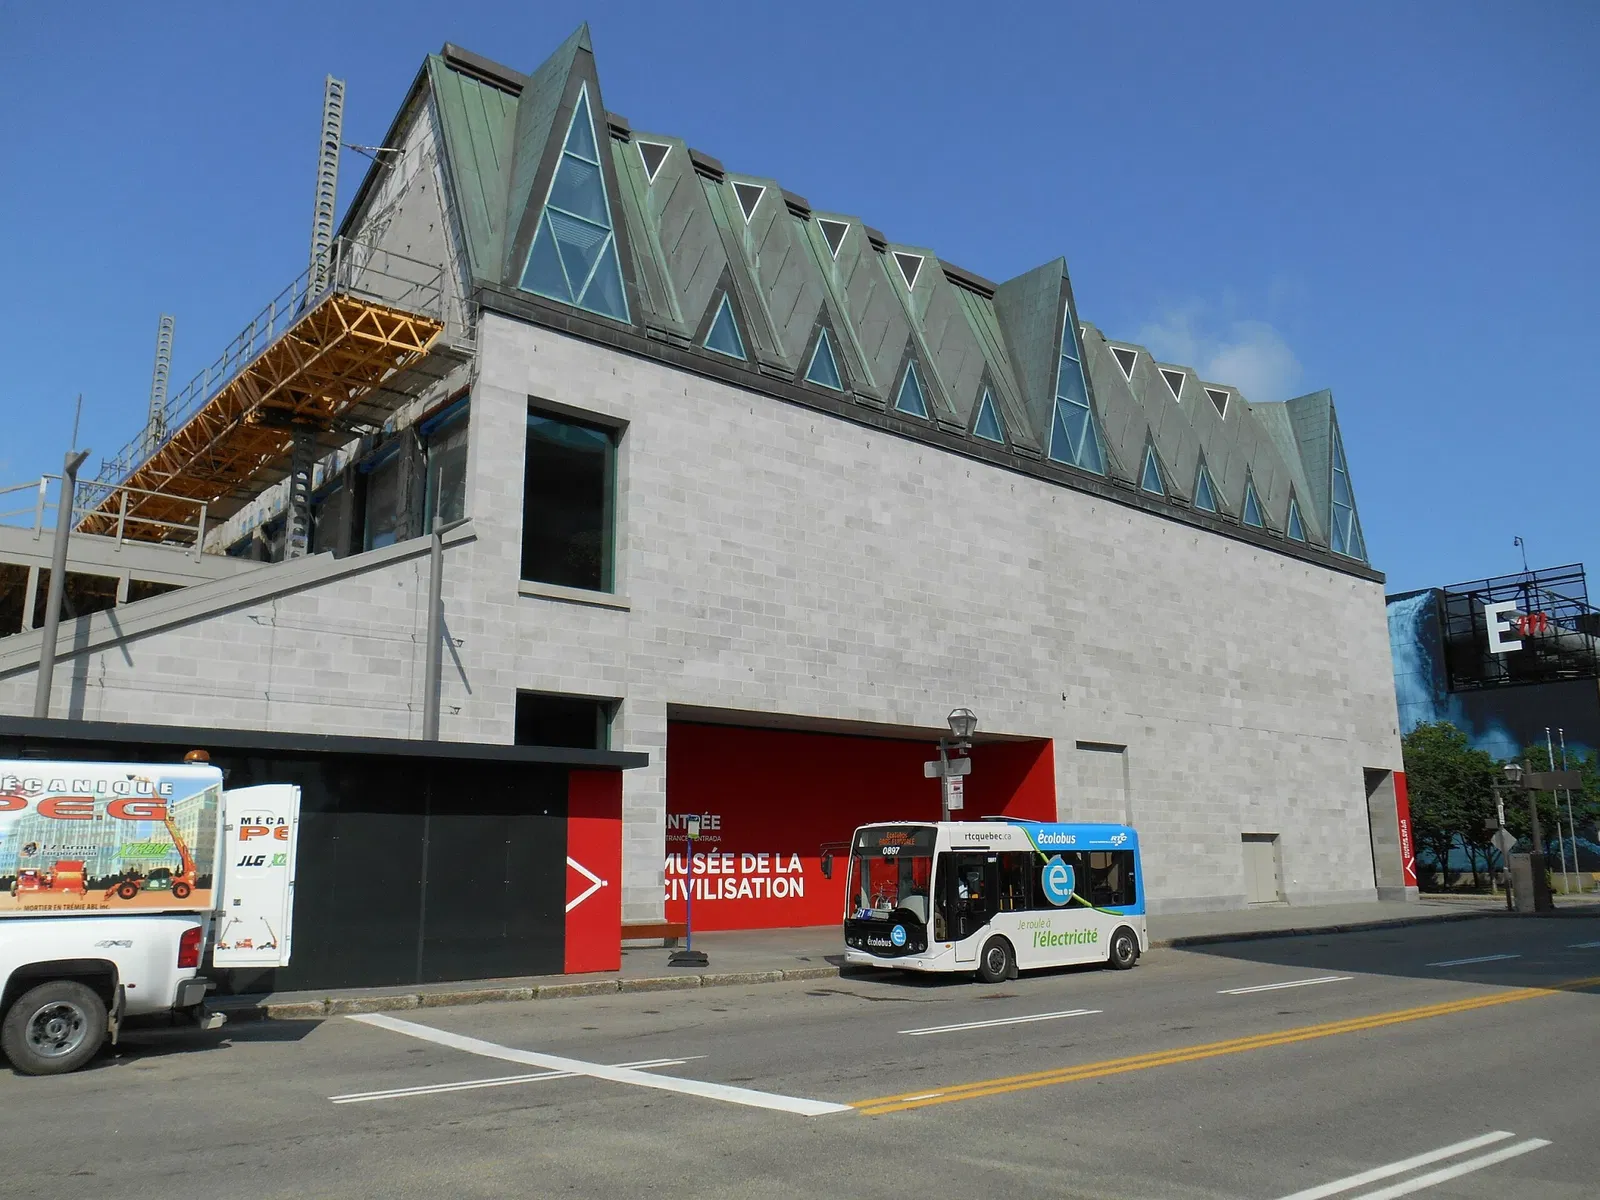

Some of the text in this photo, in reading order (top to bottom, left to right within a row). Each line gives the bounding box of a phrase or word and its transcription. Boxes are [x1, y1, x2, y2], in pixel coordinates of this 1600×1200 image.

[0, 776, 174, 796] ÉCANIQUE
[665, 811, 721, 830] NTÉE
[964, 832, 1012, 843] rtcquebec.ca
[1037, 829, 1076, 845] écolobus
[882, 846, 900, 855] 0897
[236, 855, 266, 867] JLG
[665, 847, 804, 875] MUSÉE DE LA
[1027, 919, 1045, 929] roule
[1033, 928, 1098, 948] l'électricité
